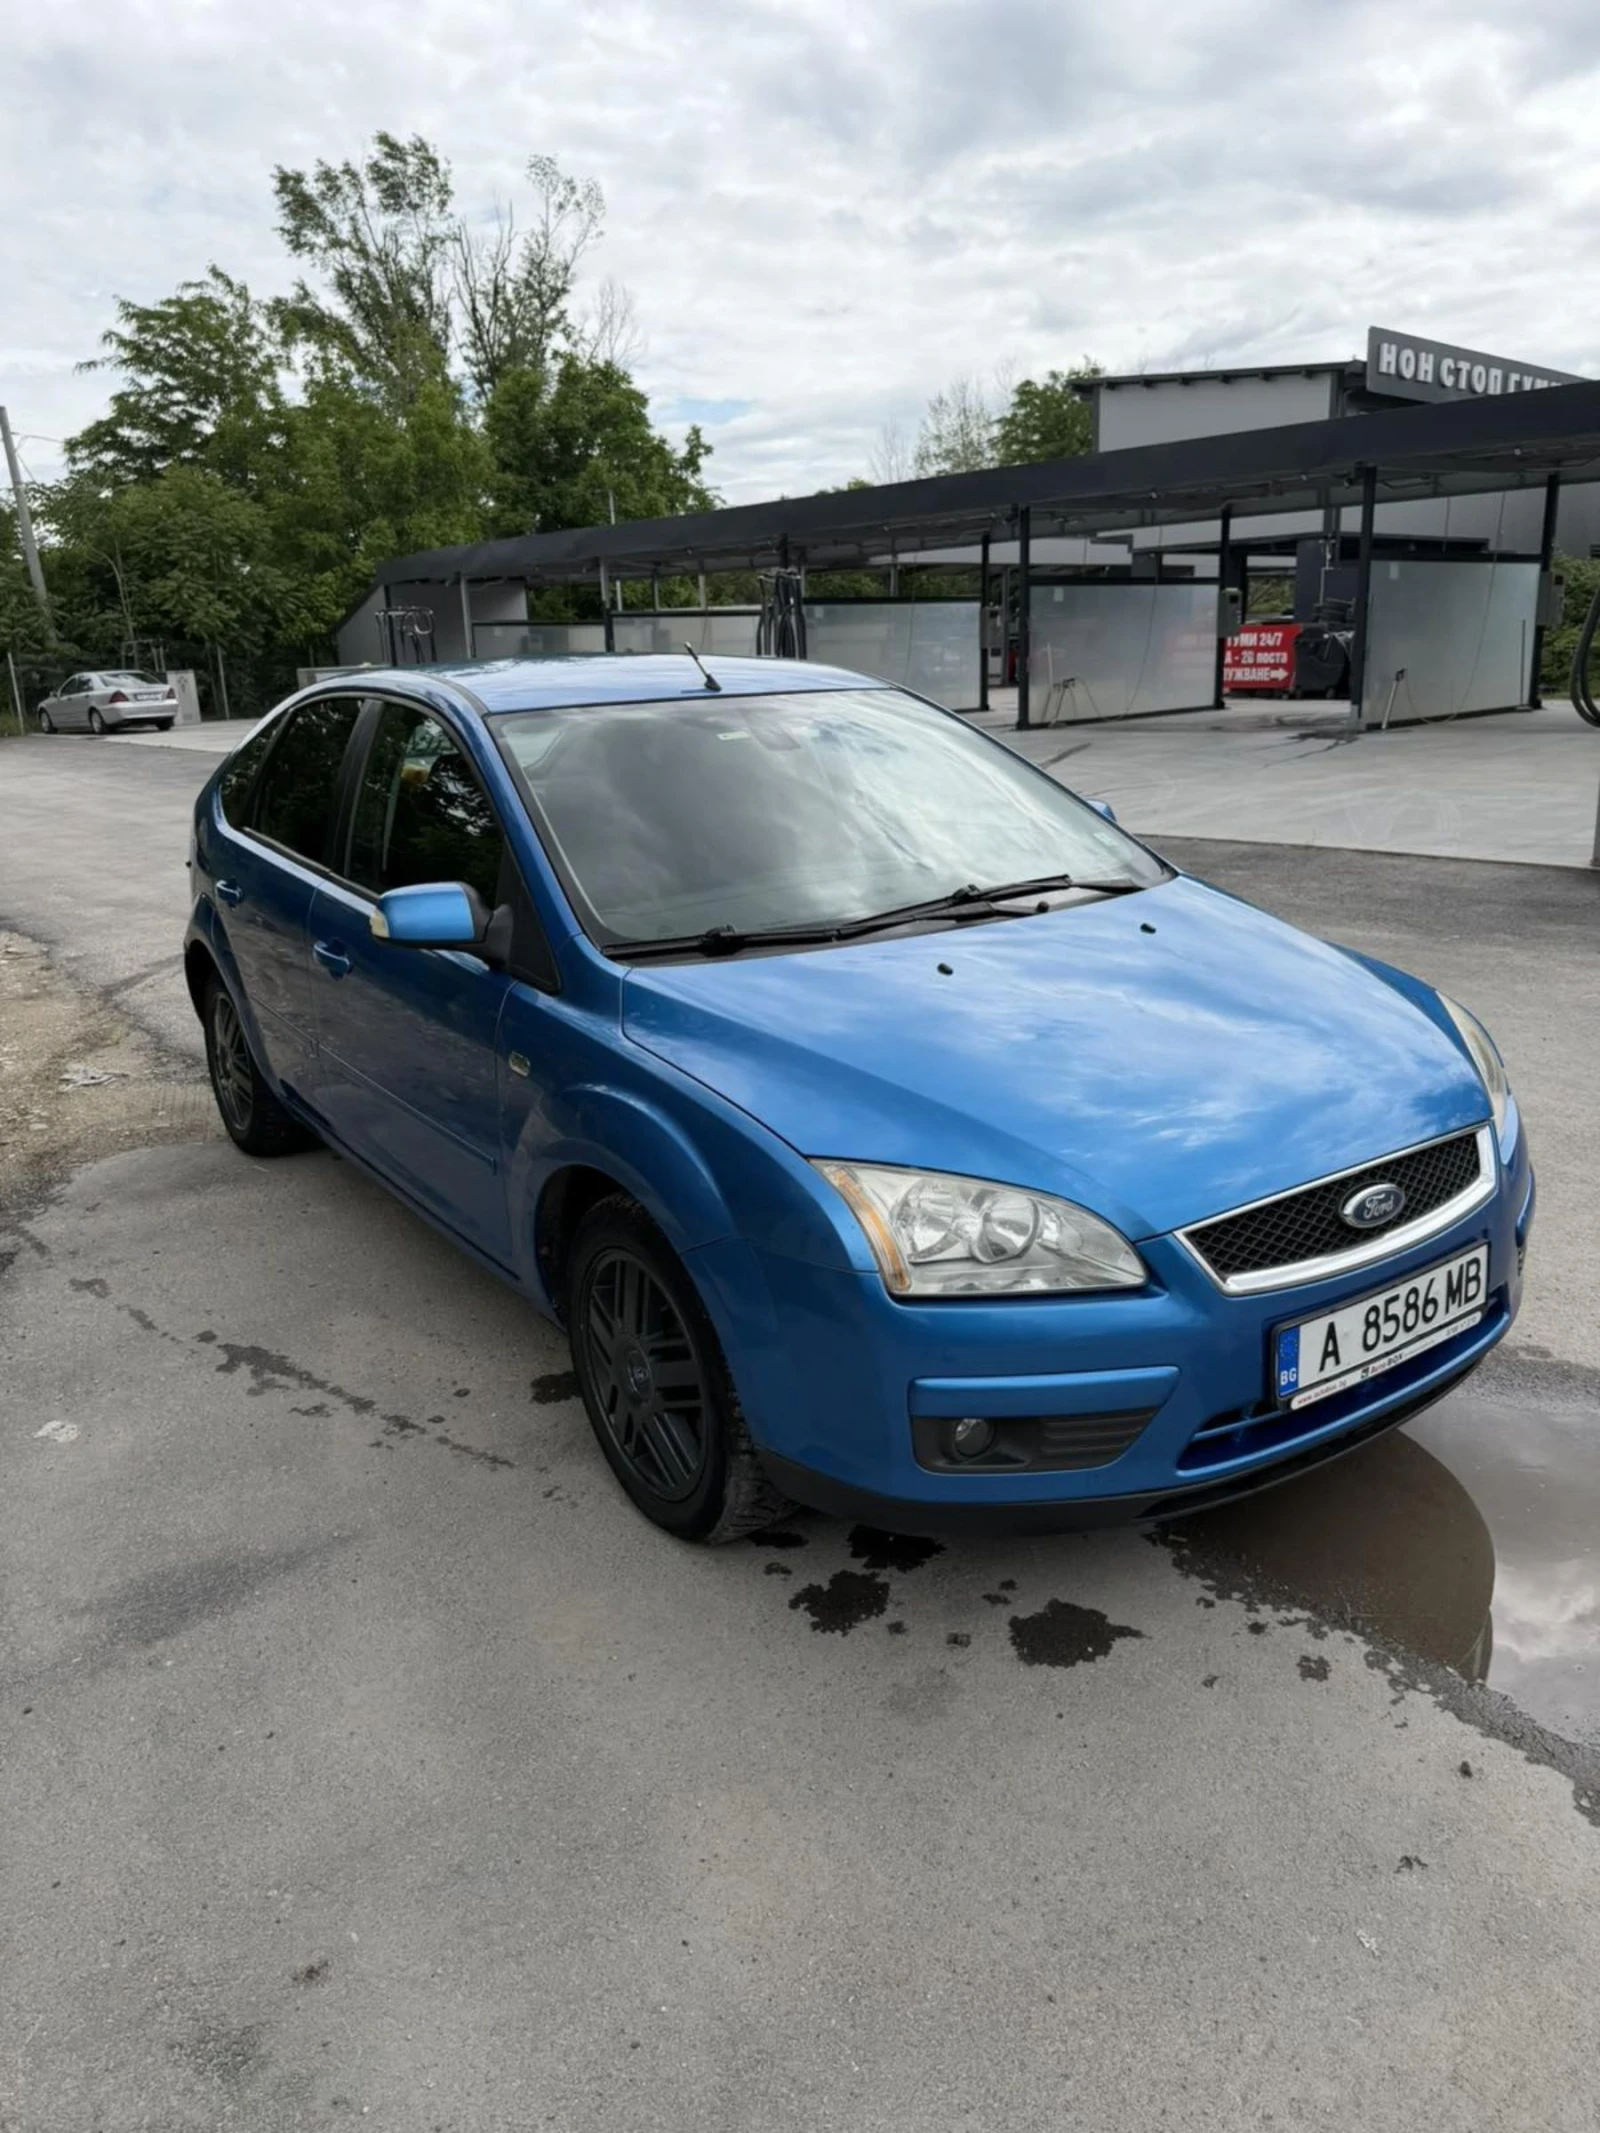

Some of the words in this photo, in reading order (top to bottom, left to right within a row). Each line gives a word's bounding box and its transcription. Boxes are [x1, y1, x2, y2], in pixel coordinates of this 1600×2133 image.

[1379, 342, 1434, 383] НОН
[1440, 357, 1503, 395] СТОП
[1259, 632, 1283, 646] 24/7
[1256, 652, 1288, 664] поста
[1363, 1193, 1394, 1219] Ford
[1319, 1320, 1341, 1373] A
[1362, 1277, 1438, 1352] 8586
[1444, 1256, 1481, 1316] MB
[1280, 1367, 1298, 1386] BG
